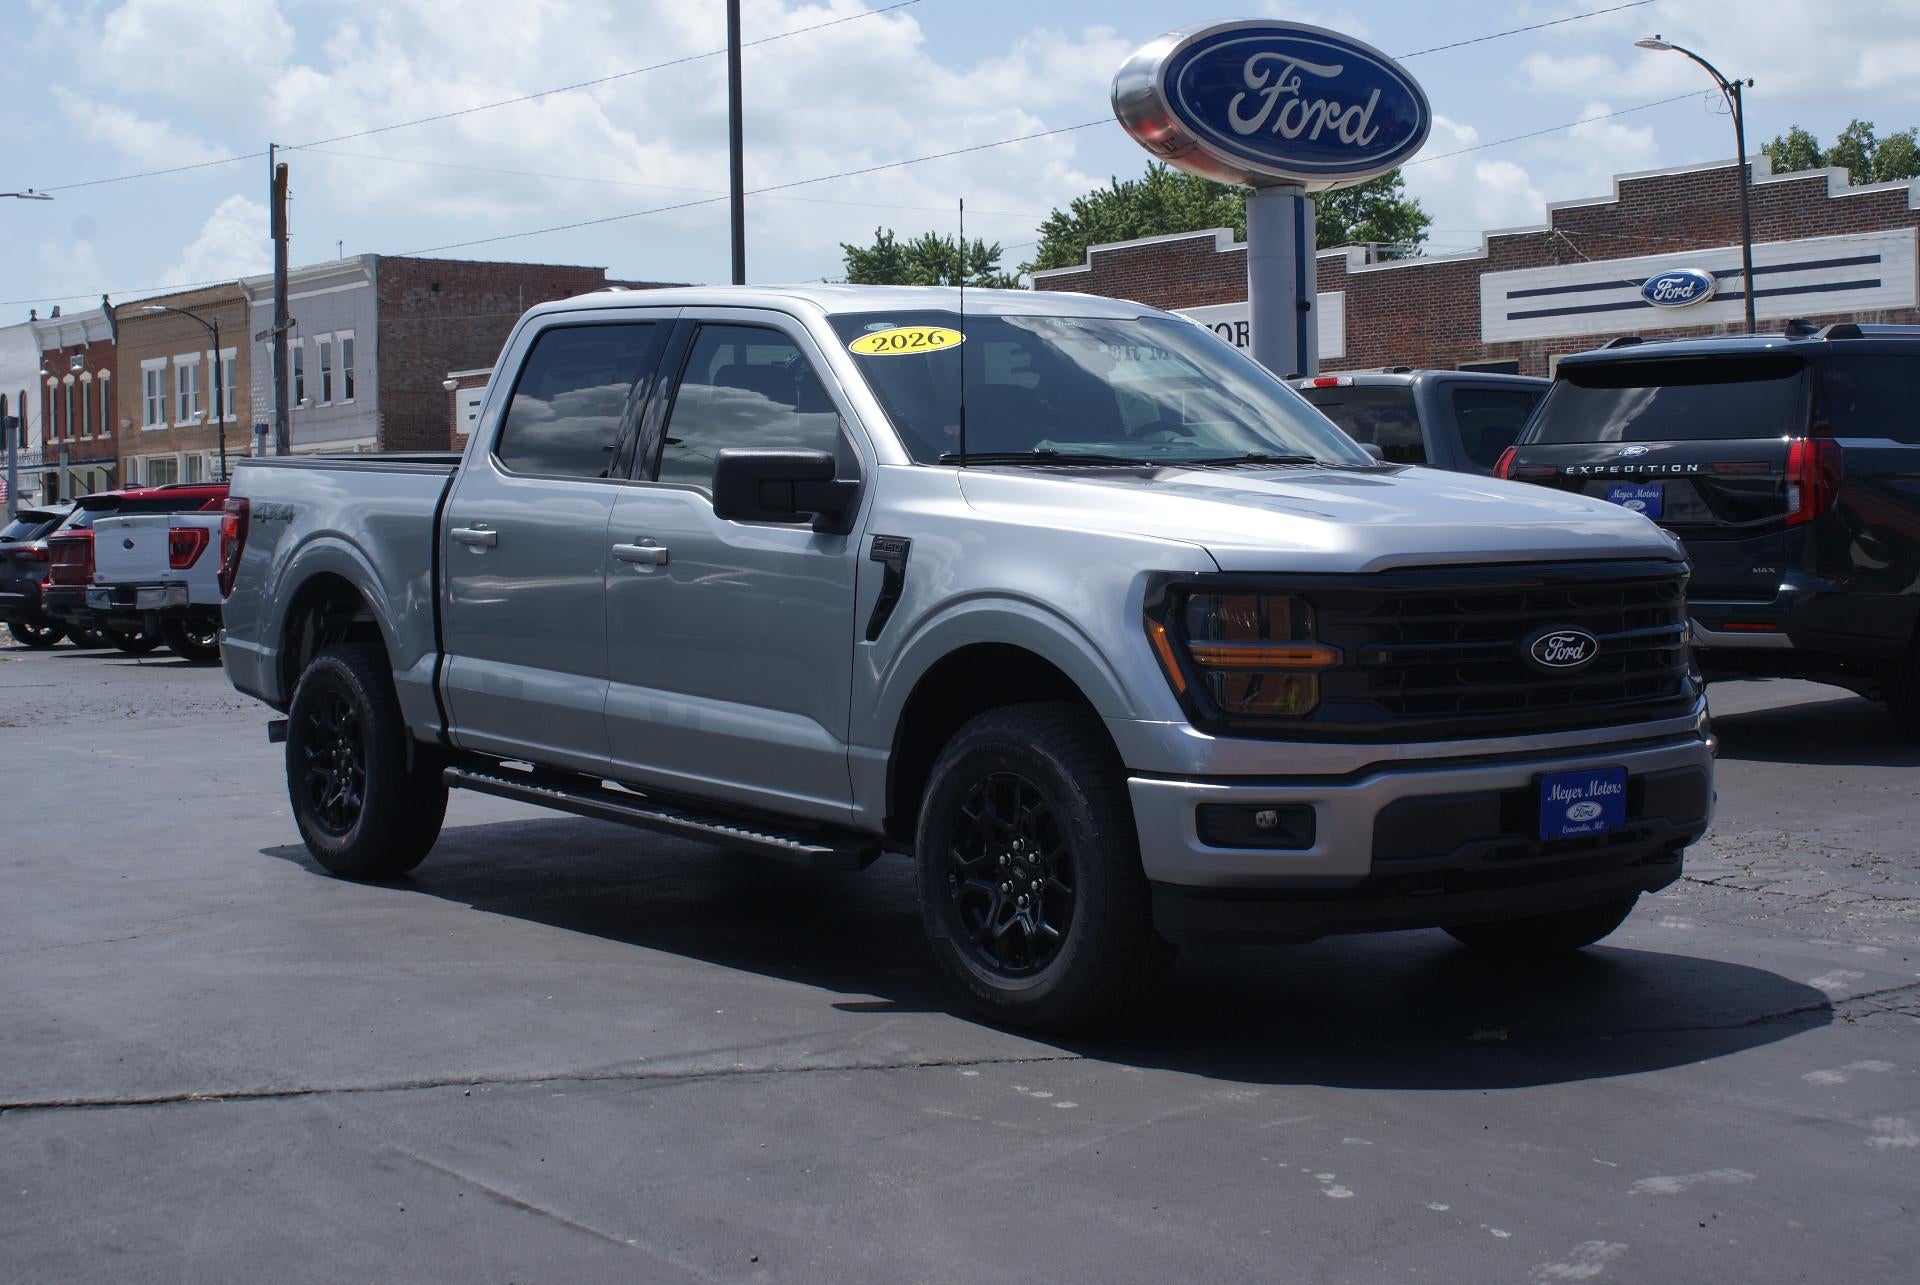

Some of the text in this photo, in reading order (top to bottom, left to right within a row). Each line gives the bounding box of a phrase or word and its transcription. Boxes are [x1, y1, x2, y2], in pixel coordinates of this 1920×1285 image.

[1227, 52, 1381, 147] Ford
[1653, 277, 1695, 300] Ford
[871, 331, 945, 352] 2026
[1205, 321, 1250, 348] OR
[1566, 464, 1699, 475] EXPEDITION
[1544, 636, 1585, 661] Ford
[1548, 780, 1622, 804] Meyer Motors
[1574, 805, 1594, 818] Ford
